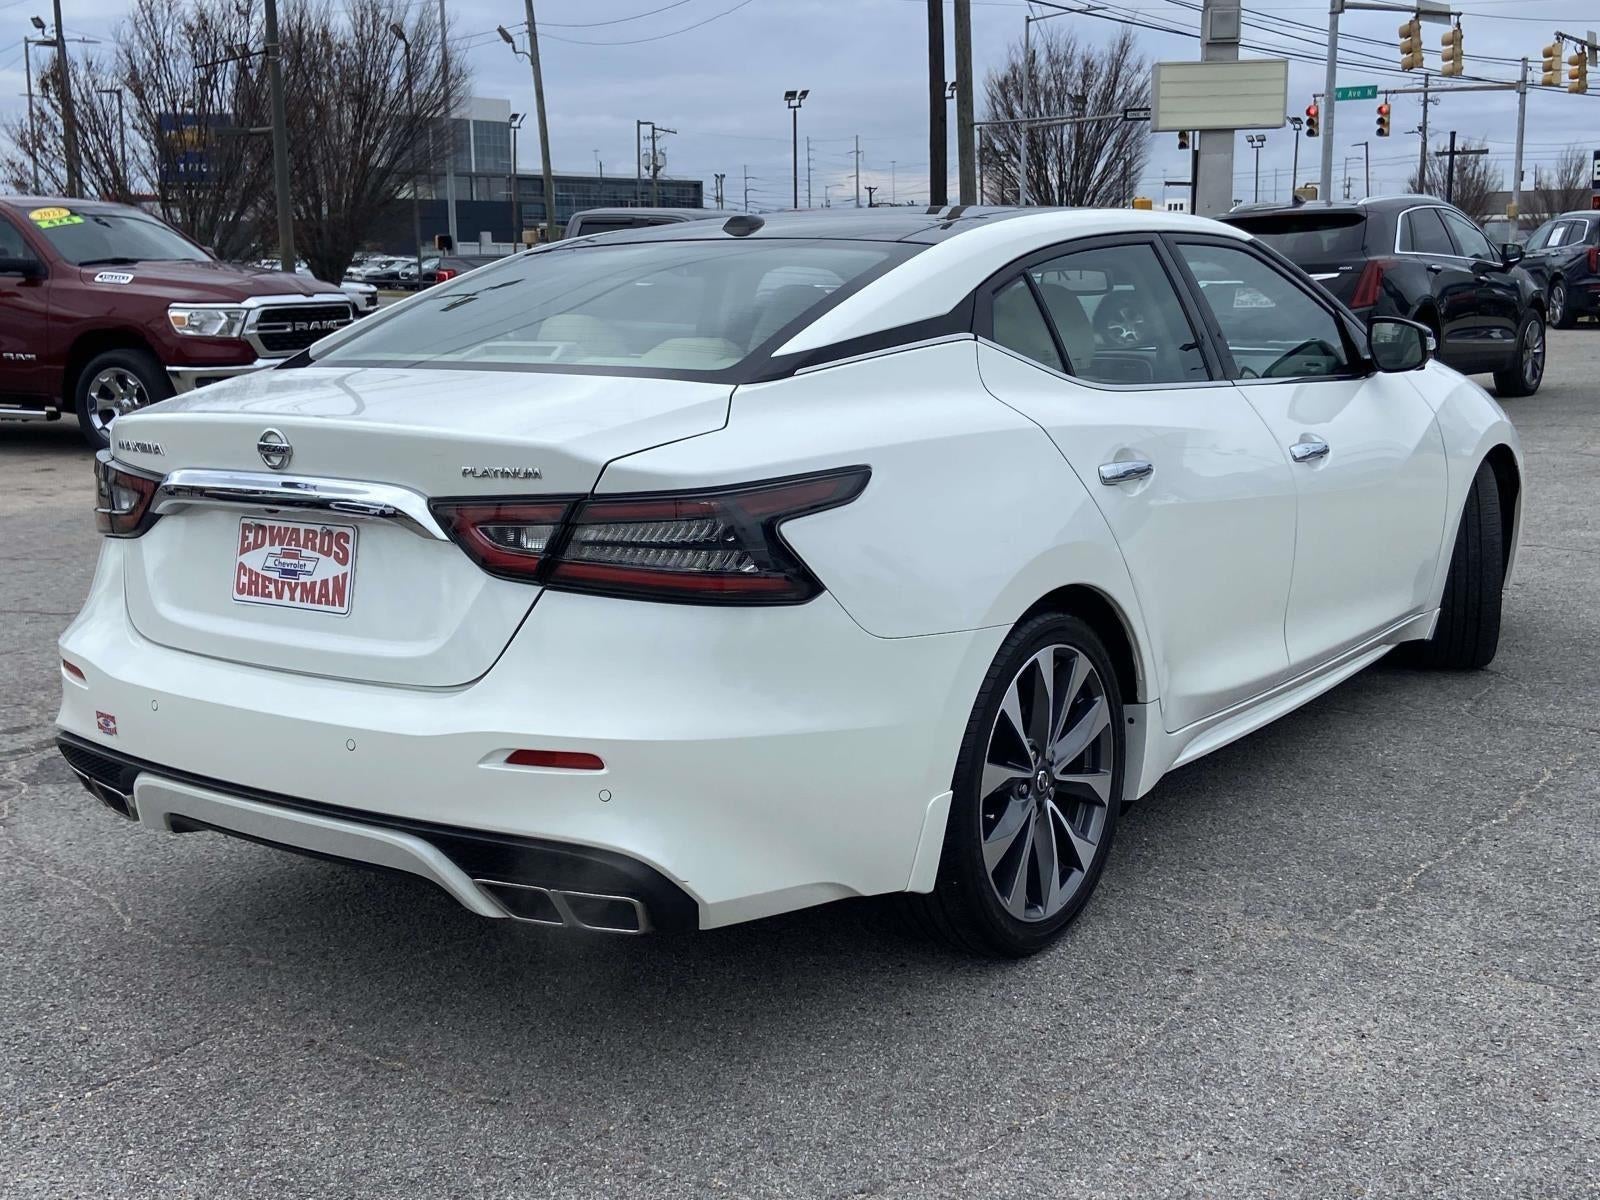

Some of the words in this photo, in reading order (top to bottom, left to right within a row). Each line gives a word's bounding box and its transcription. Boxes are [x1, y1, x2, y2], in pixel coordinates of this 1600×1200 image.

[1347, 90, 1361, 98] Ave
[1367, 88, 1373, 97] N
[294, 320, 337, 332] RAM
[2, 353, 36, 361] RAM
[118, 440, 165, 456] MAXIMA
[461, 466, 542, 480] PLATINUM
[239, 523, 350, 567] EDWARDS
[273, 559, 306, 571] Chevrolet
[236, 561, 348, 608] CHEVYMAN
